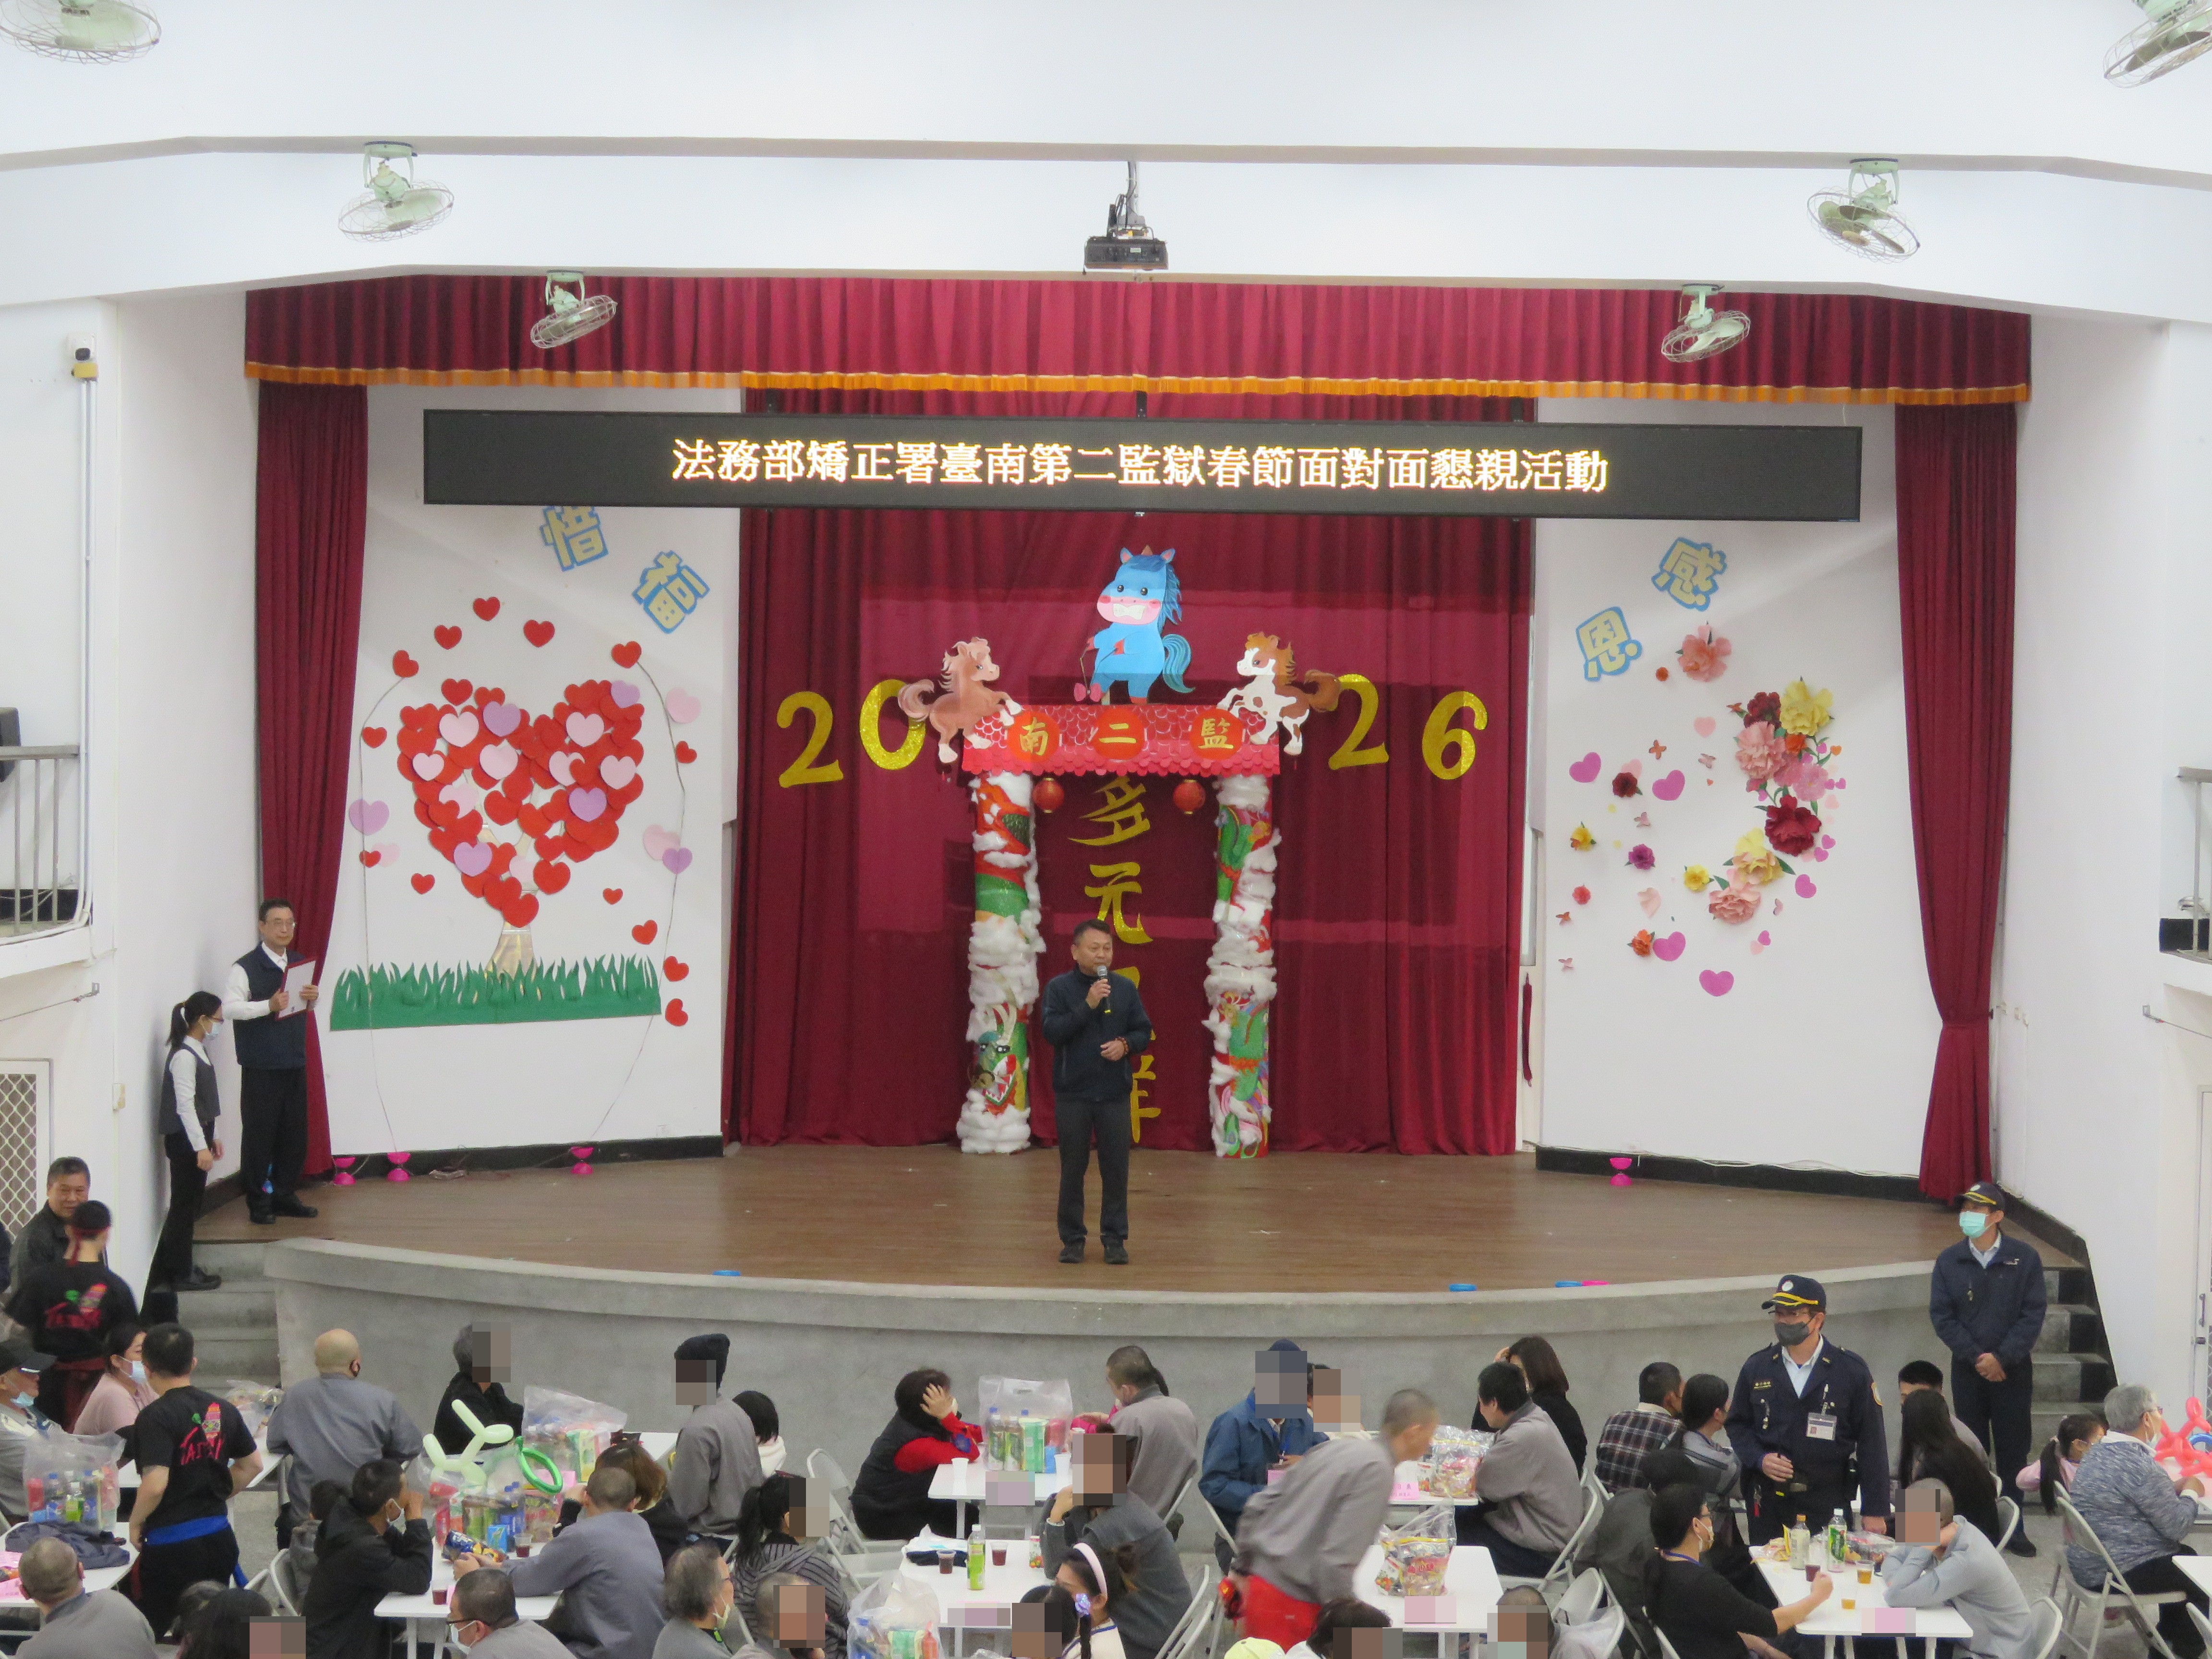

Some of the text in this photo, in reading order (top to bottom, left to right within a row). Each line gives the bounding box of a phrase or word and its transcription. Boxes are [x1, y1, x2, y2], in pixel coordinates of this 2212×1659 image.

[672, 438, 1609, 493] 法務部矯正署臺南第二監獄春節面對面懇親活動
[1575, 537, 1728, 682] 感恩
[1019, 717, 1234, 756] 南二監
